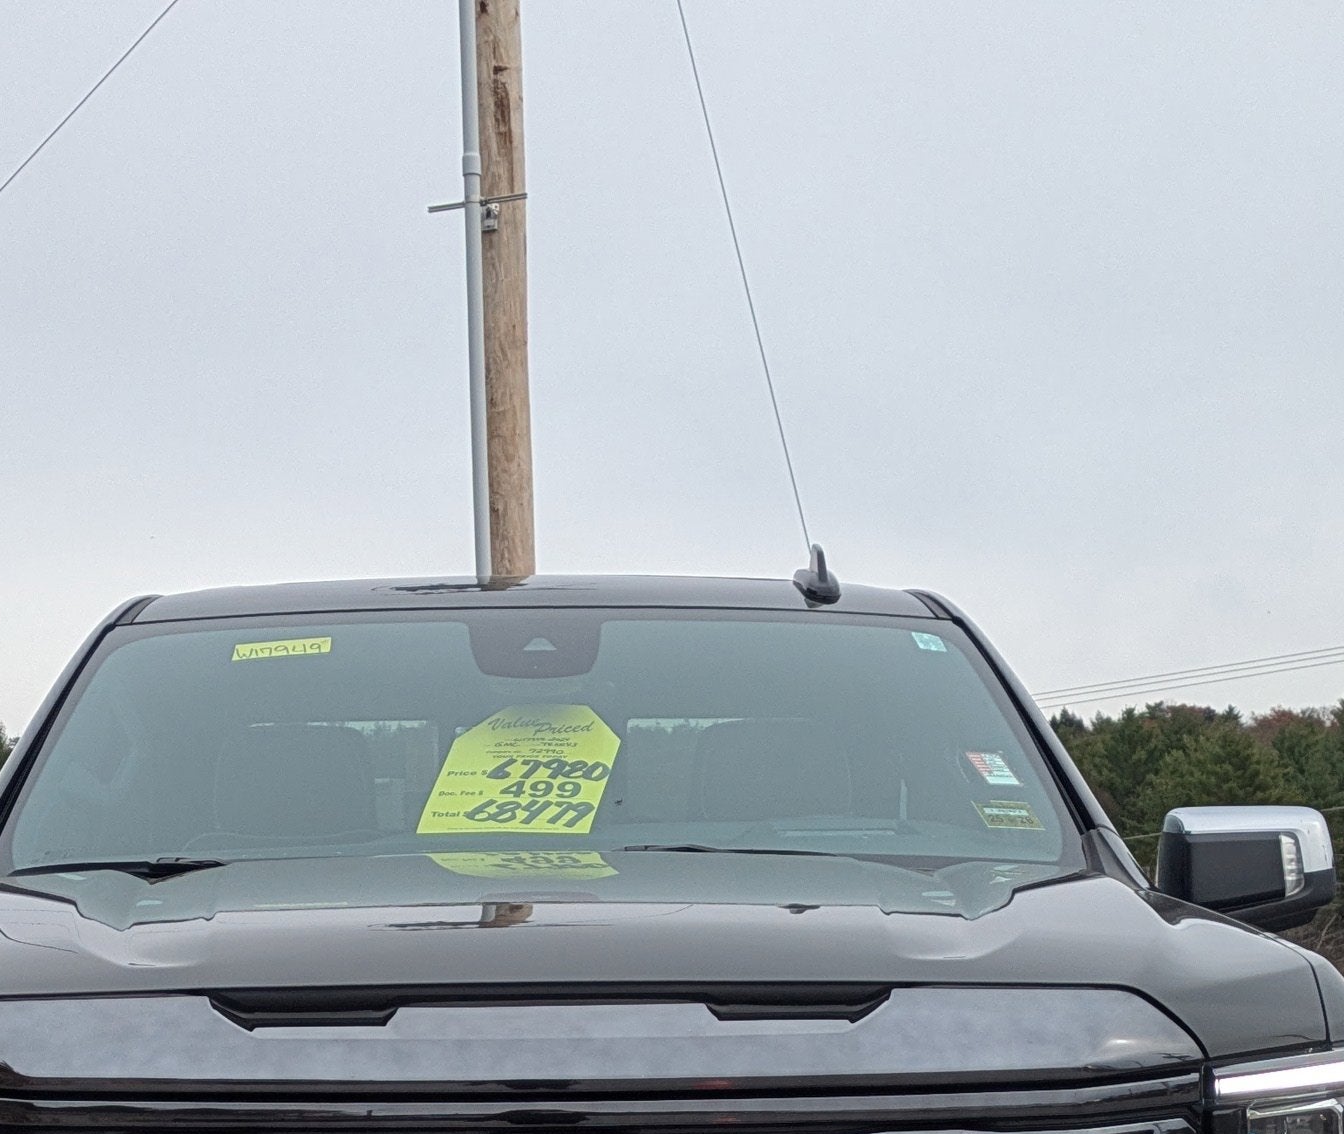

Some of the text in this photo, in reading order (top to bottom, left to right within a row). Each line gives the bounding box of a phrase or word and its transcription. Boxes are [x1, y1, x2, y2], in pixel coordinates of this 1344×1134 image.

[488, 717, 540, 731] Value
[533, 721, 595, 736] Priced
[486, 758, 610, 781] 67980
[499, 780, 582, 798] 499
[431, 810, 460, 818] Total
[465, 799, 595, 828] 68479
